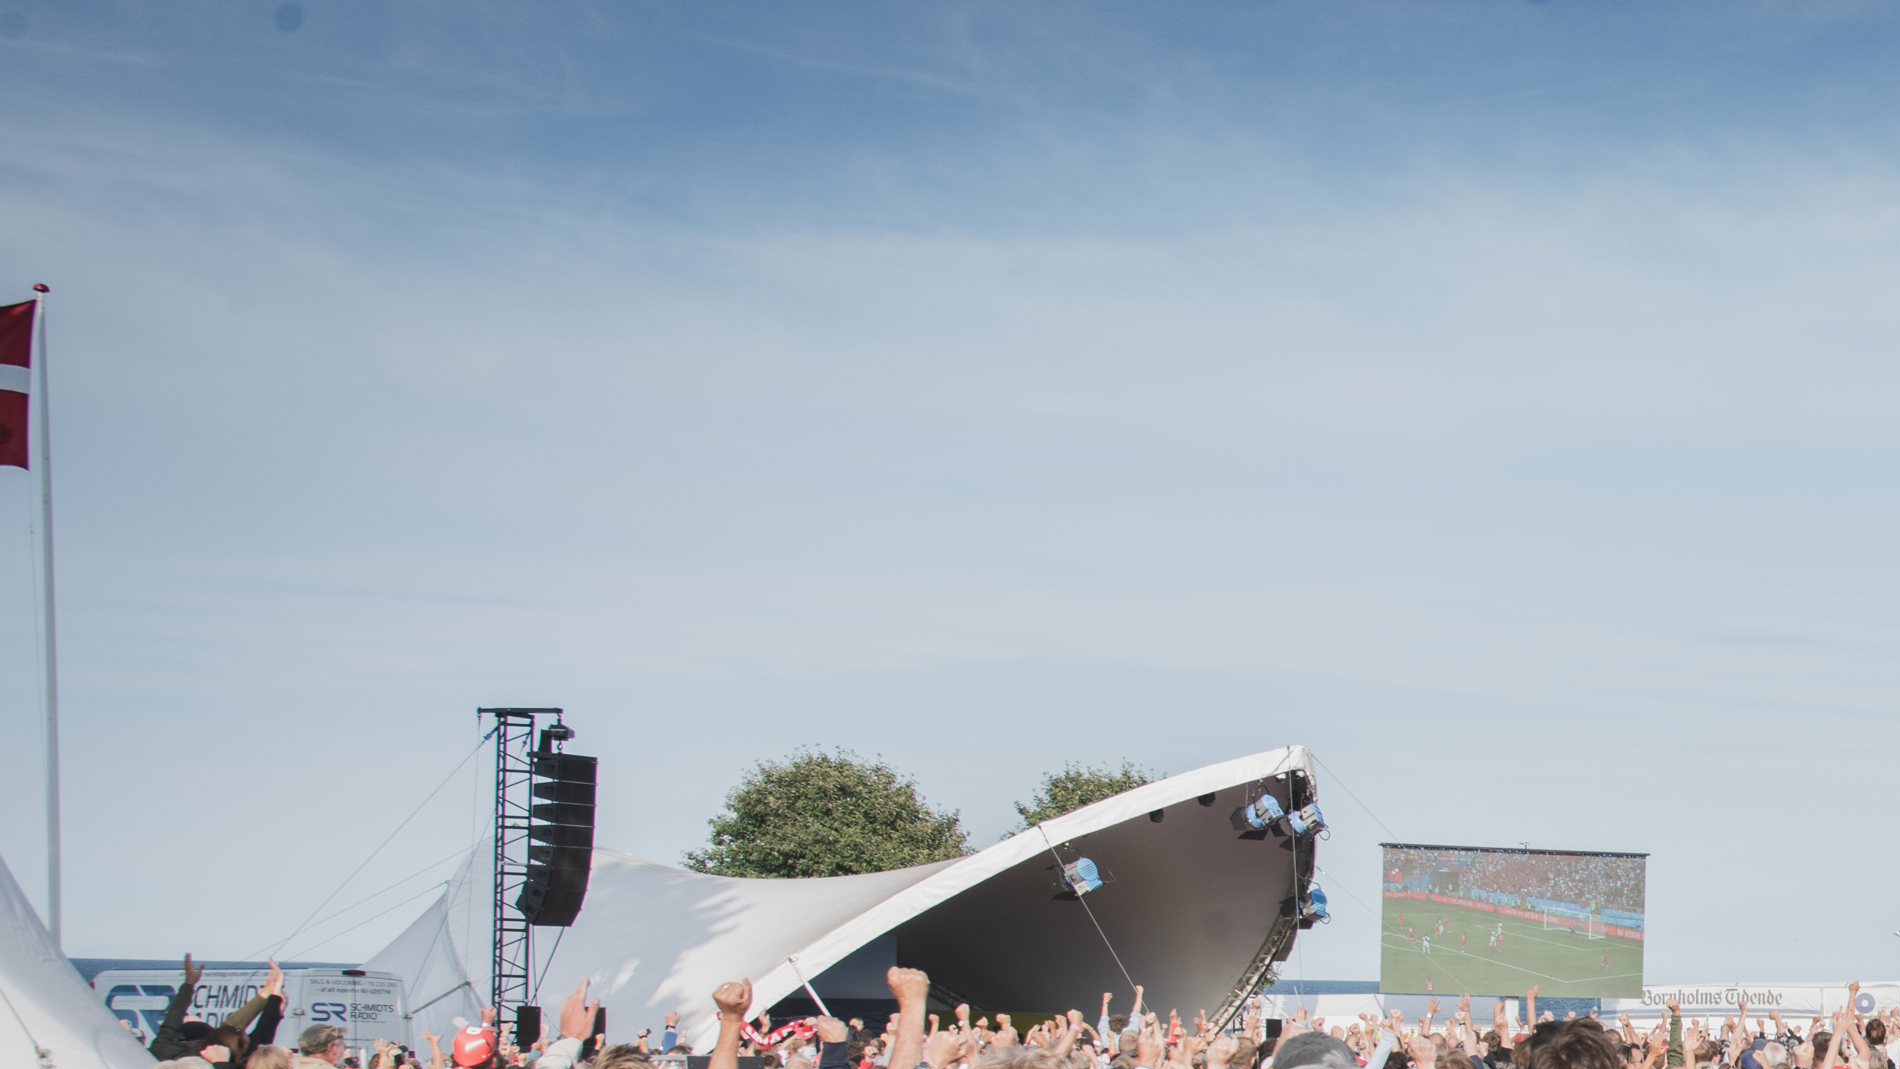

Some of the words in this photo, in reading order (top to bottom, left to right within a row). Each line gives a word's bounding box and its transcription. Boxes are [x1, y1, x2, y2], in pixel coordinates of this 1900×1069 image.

[1640, 989, 1722, 1006] Bornholms
[1725, 988, 1783, 1006] Tidende
[311, 1002, 347, 1022] SR
[350, 1003, 394, 1013] SCHMIDTS
[350, 1012, 378, 1020] RADIO
